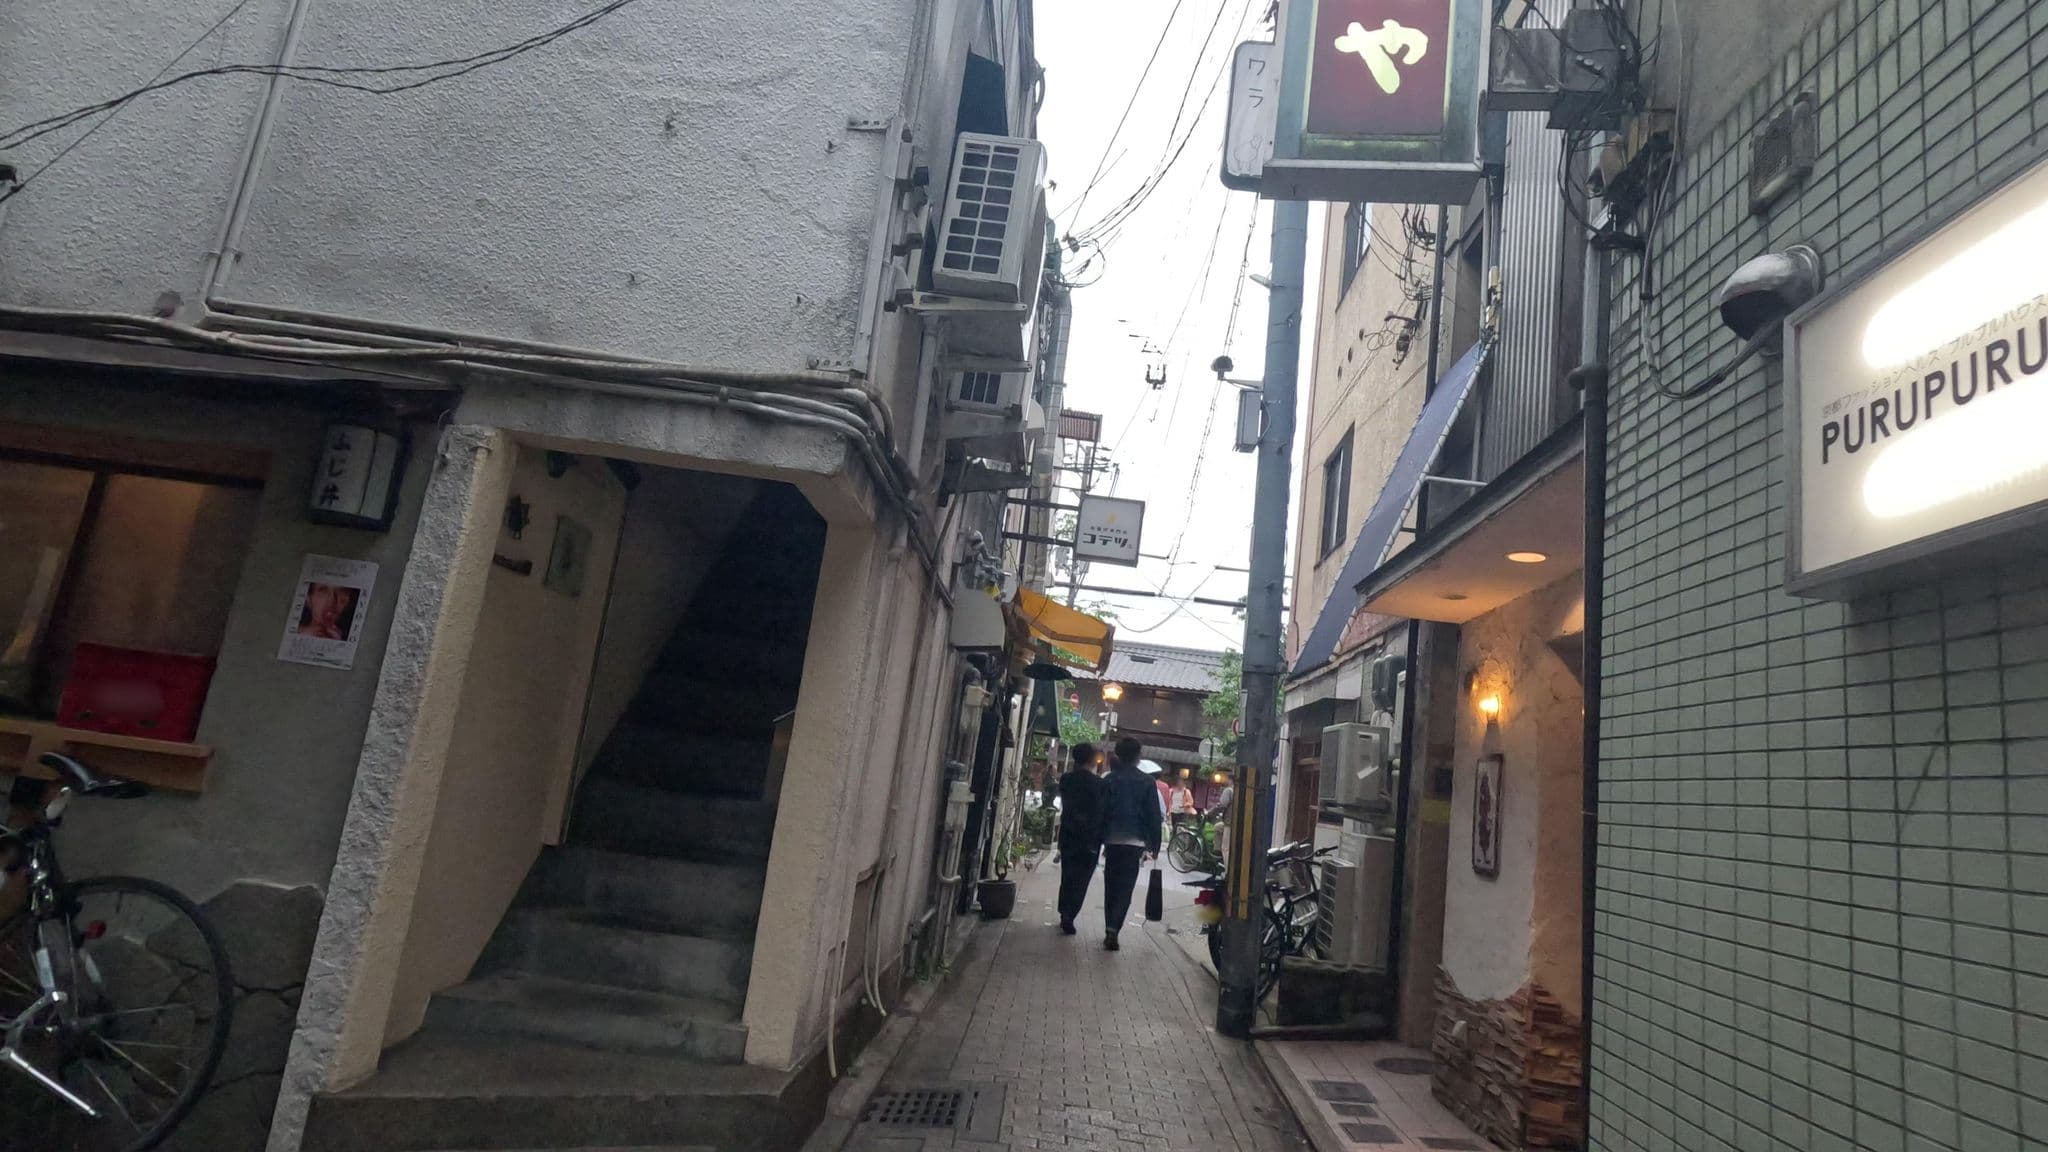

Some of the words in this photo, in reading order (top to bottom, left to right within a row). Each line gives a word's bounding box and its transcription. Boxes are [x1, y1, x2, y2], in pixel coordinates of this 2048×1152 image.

[1248, 58, 1266, 109] ワラ
[1334, 19, 1429, 95] や
[1822, 315, 2048, 465] PURUPURU
[1082, 533, 1129, 548] コテツ
